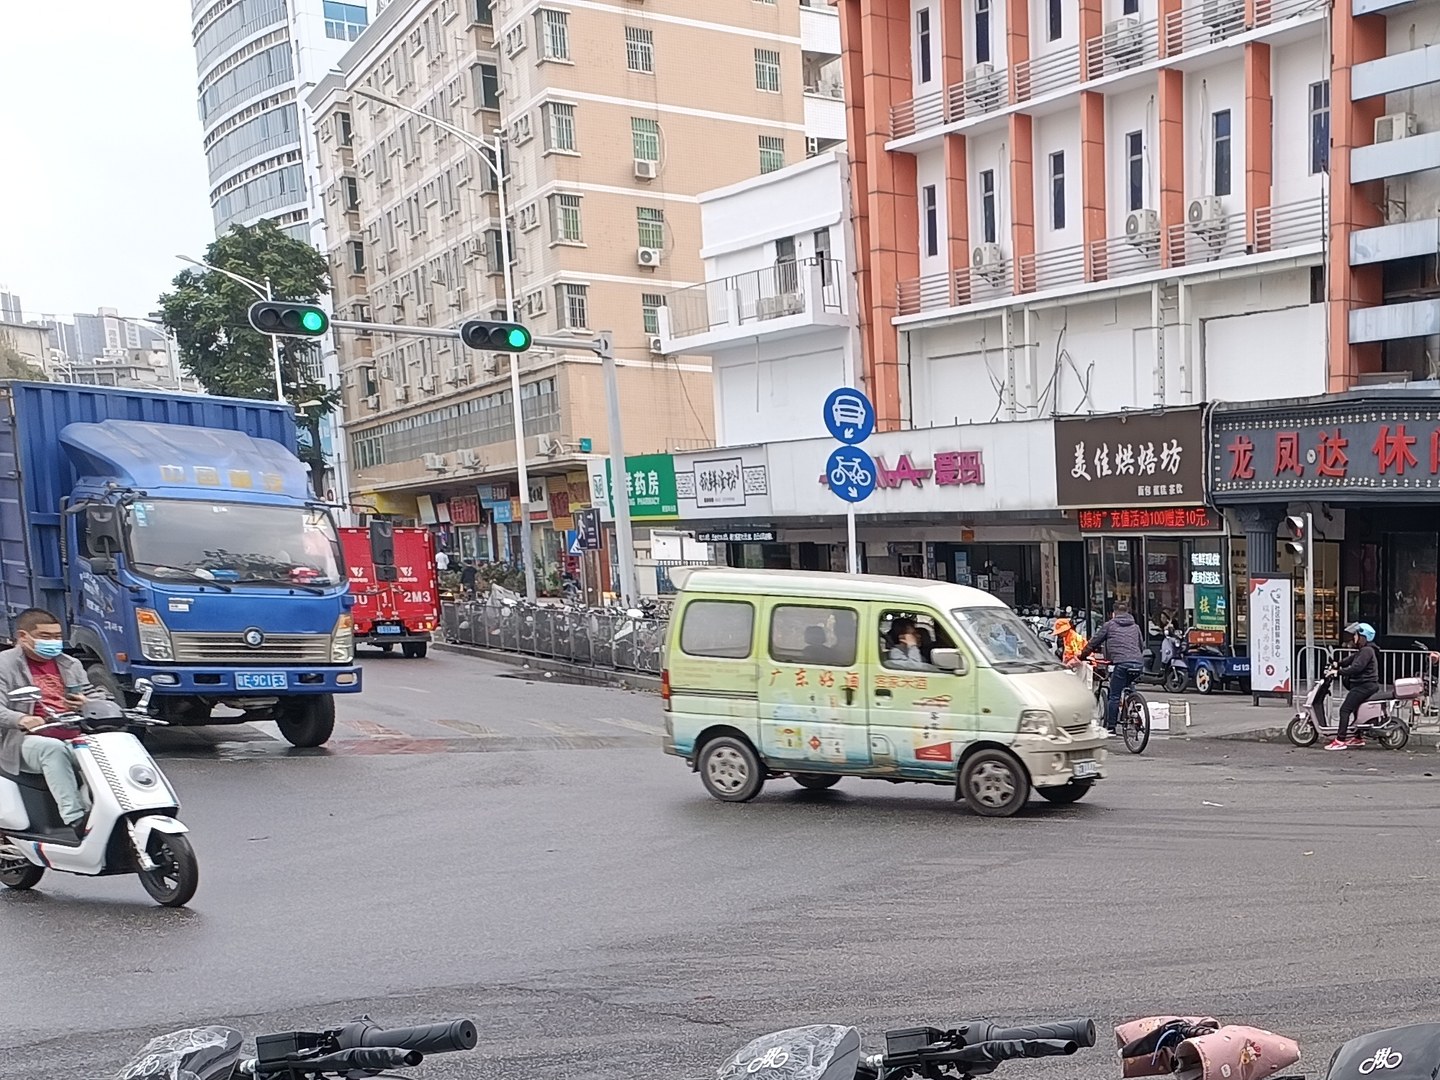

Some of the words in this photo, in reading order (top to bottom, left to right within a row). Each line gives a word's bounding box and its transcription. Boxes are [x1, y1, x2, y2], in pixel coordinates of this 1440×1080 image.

[1071, 439, 1182, 480] 美佳烘焙坊
